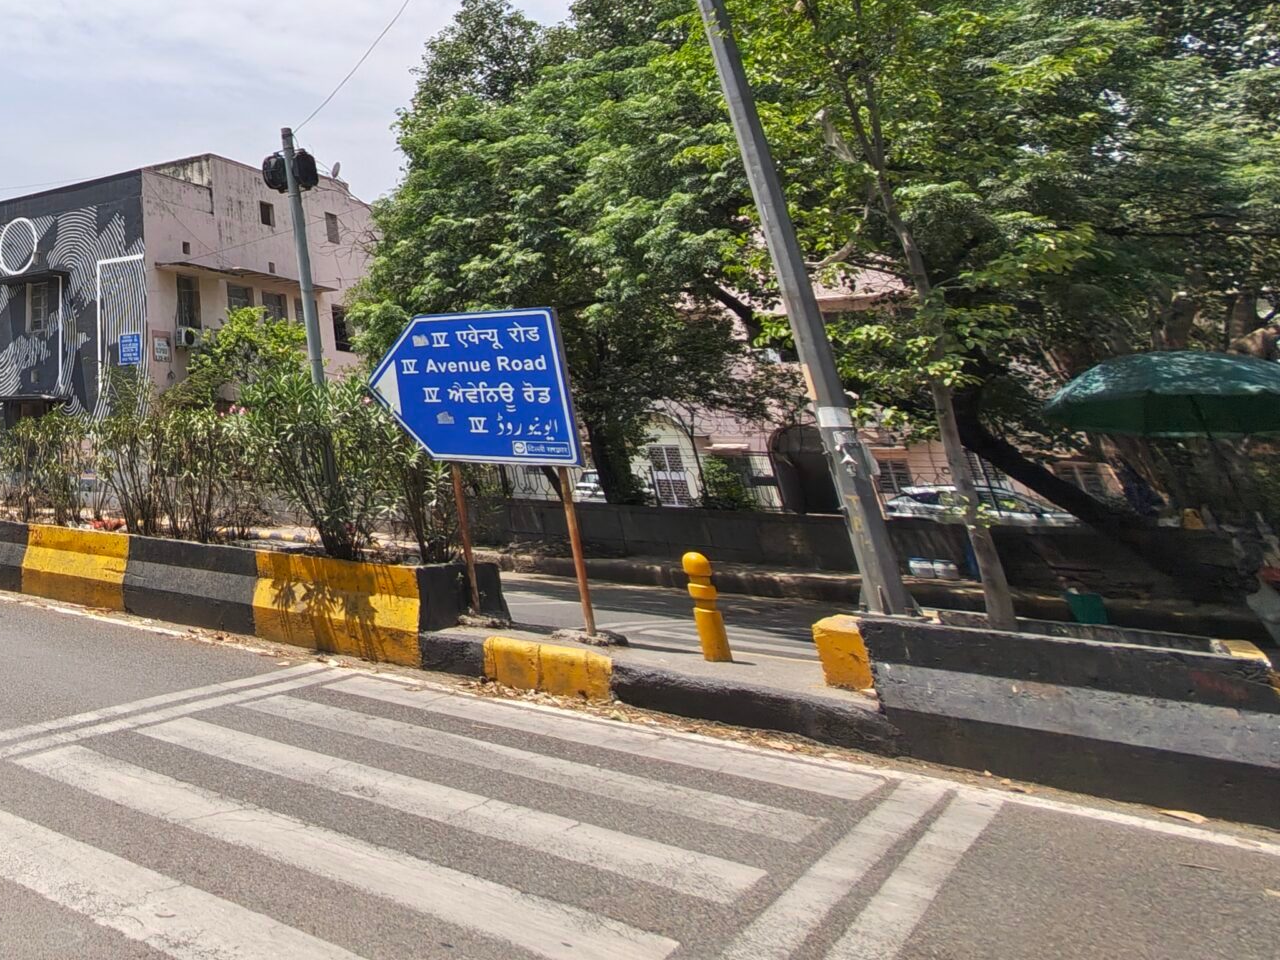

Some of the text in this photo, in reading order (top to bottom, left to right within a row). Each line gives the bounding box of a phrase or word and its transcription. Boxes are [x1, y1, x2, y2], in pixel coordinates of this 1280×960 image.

[431, 321, 540, 349] IV एवेन्यू रोड
[401, 354, 547, 374] IV Avenue Road
[422, 387, 442, 402] IV
[522, 380, 551, 403] ਰੋਡ
[468, 416, 489, 433] IV
